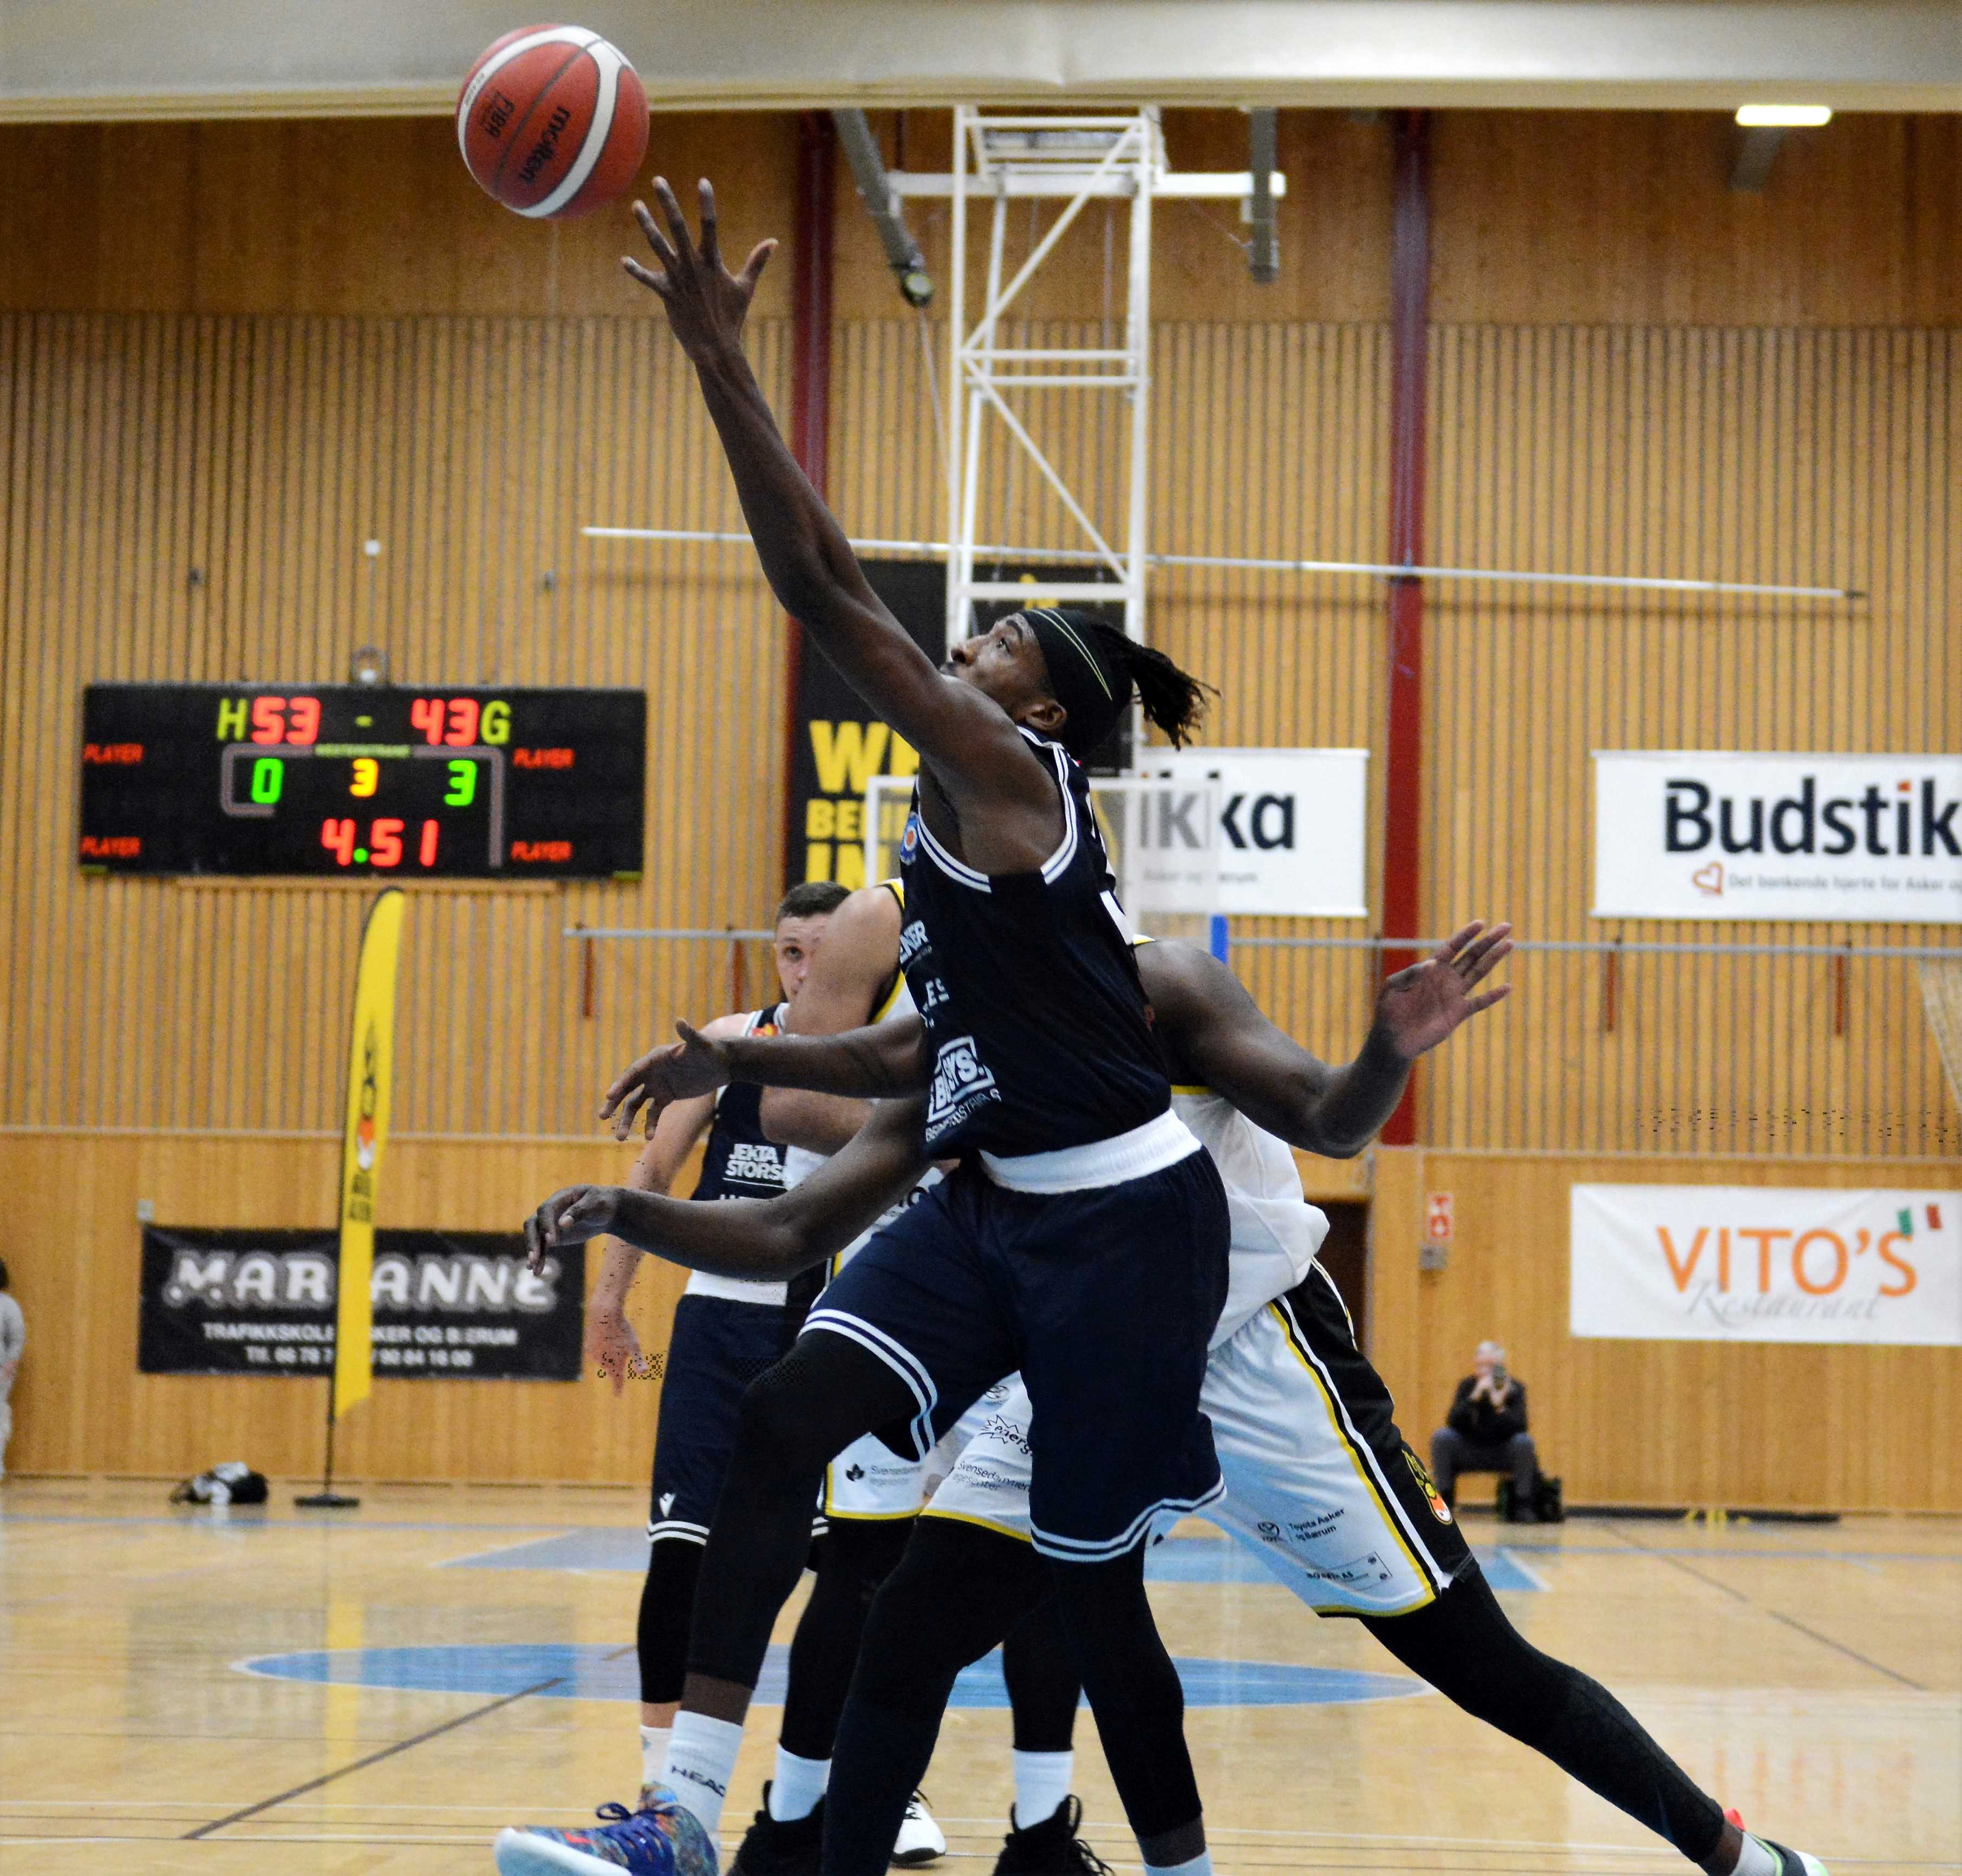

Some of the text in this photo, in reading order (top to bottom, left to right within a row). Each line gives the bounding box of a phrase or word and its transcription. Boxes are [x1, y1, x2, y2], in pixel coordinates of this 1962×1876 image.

[519, 106, 571, 185] molten
[83, 743, 144, 765] PLAYER
[512, 748, 576, 769] PLAYER
[251, 757, 478, 806] 0 3 3
[1139, 769, 1296, 849] ikka
[80, 836, 141, 858] PLAYER
[510, 841, 573, 862] PLAYER
[1655, 1225, 1918, 1297] VITO'S
[165, 1255, 555, 1306] MARANNE
[1685, 1279, 1882, 1328] Restaurant
[415, 1326, 443, 1343] OG
[1289, 1507, 1345, 1532] Toyota Asker
